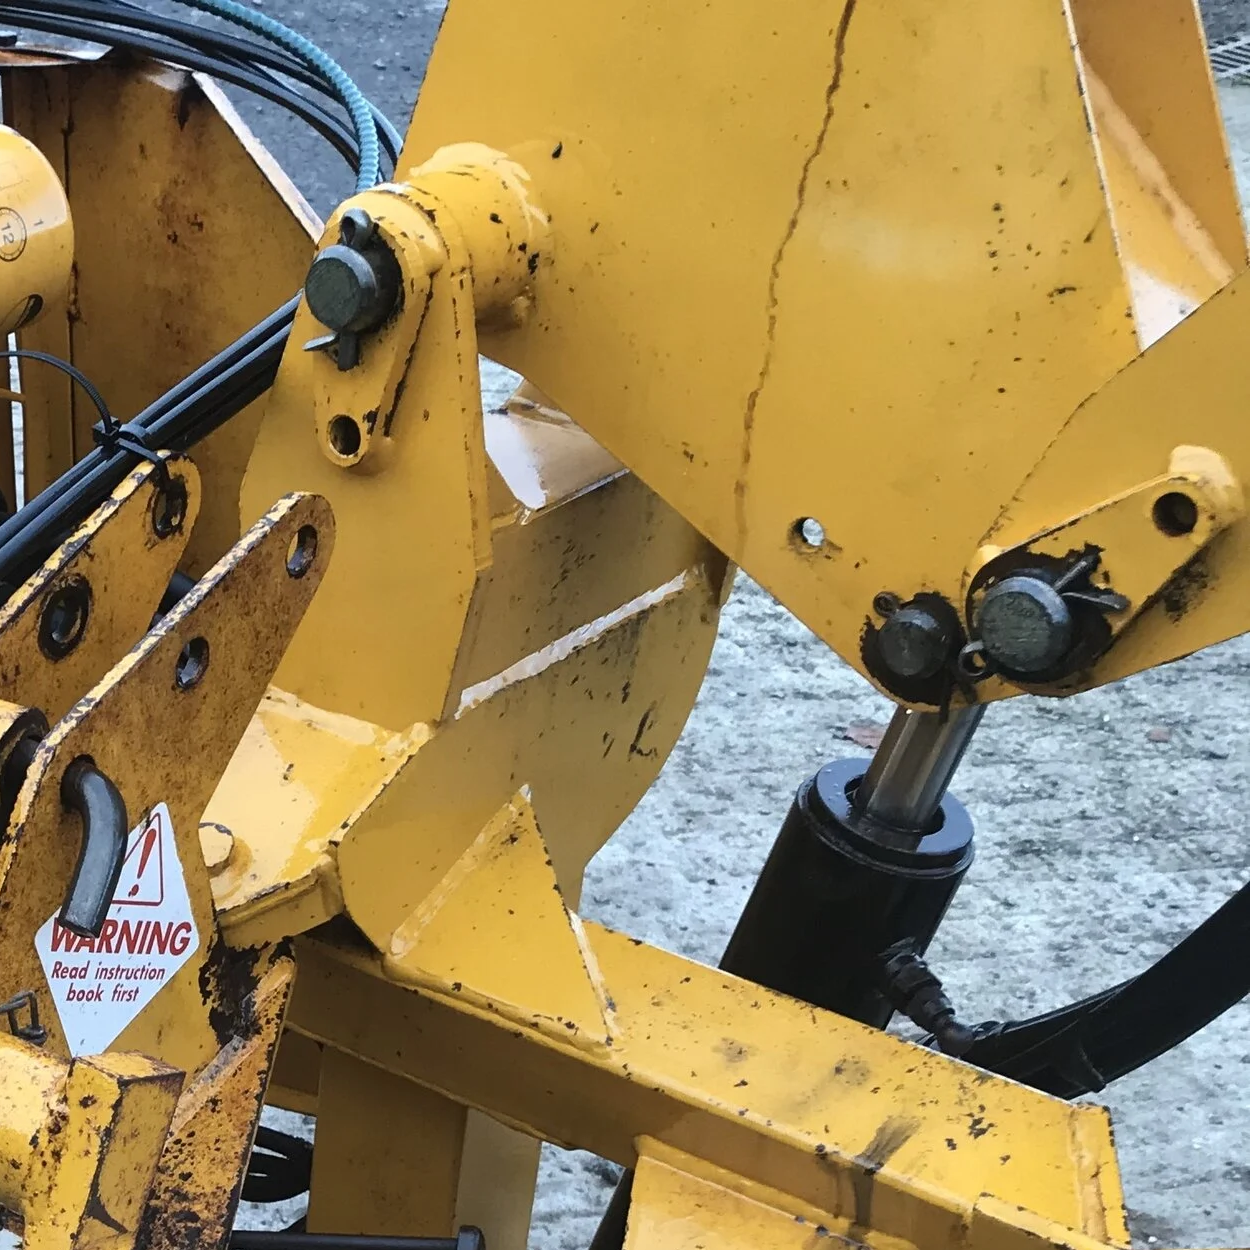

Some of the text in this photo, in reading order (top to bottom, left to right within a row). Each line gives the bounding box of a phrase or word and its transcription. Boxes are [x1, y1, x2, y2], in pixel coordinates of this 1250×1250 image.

[1, 222, 15, 244] 12
[51, 917, 192, 956] WARNING
[52, 960, 166, 981] Read instruction
[66, 983, 140, 1002] book first
